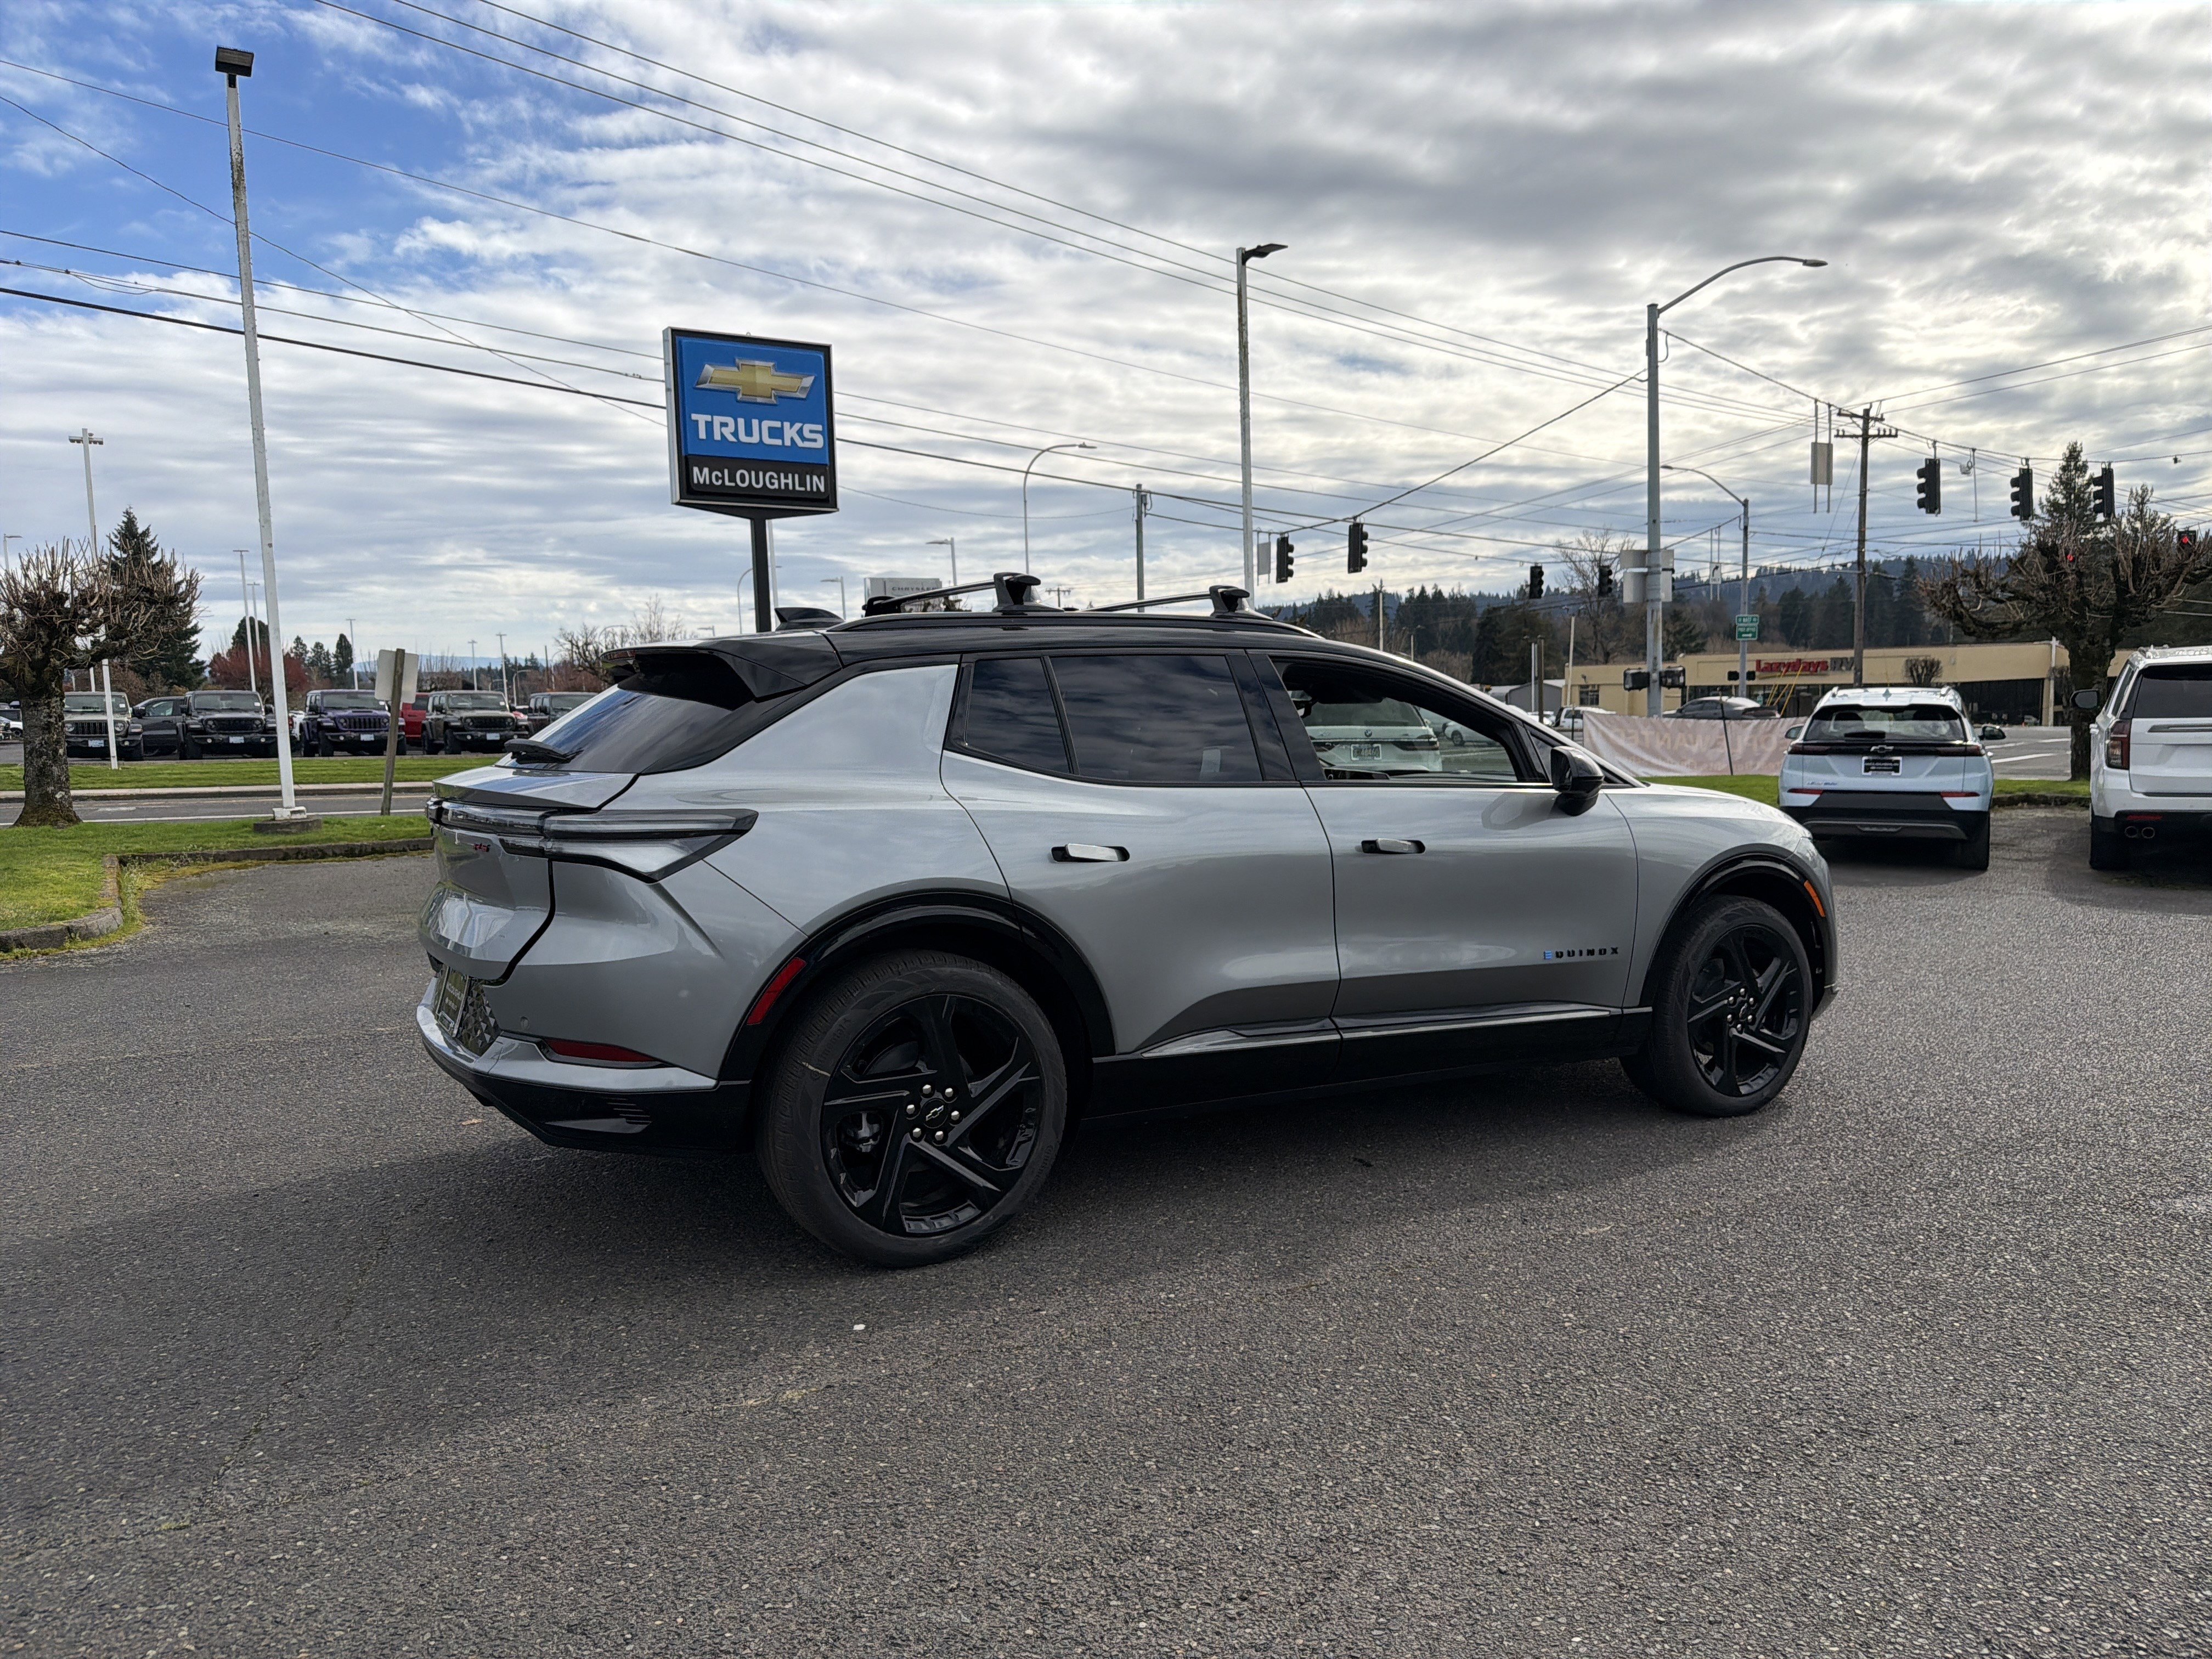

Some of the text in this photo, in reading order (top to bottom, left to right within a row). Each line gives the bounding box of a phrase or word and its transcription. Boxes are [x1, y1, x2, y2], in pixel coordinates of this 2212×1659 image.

[691, 413, 824, 449] TRUCKS
[693, 466, 825, 493] McLOUGHLIN
[1756, 658, 1829, 674] Lazydays
[1544, 947, 1618, 960] EQUINOX
